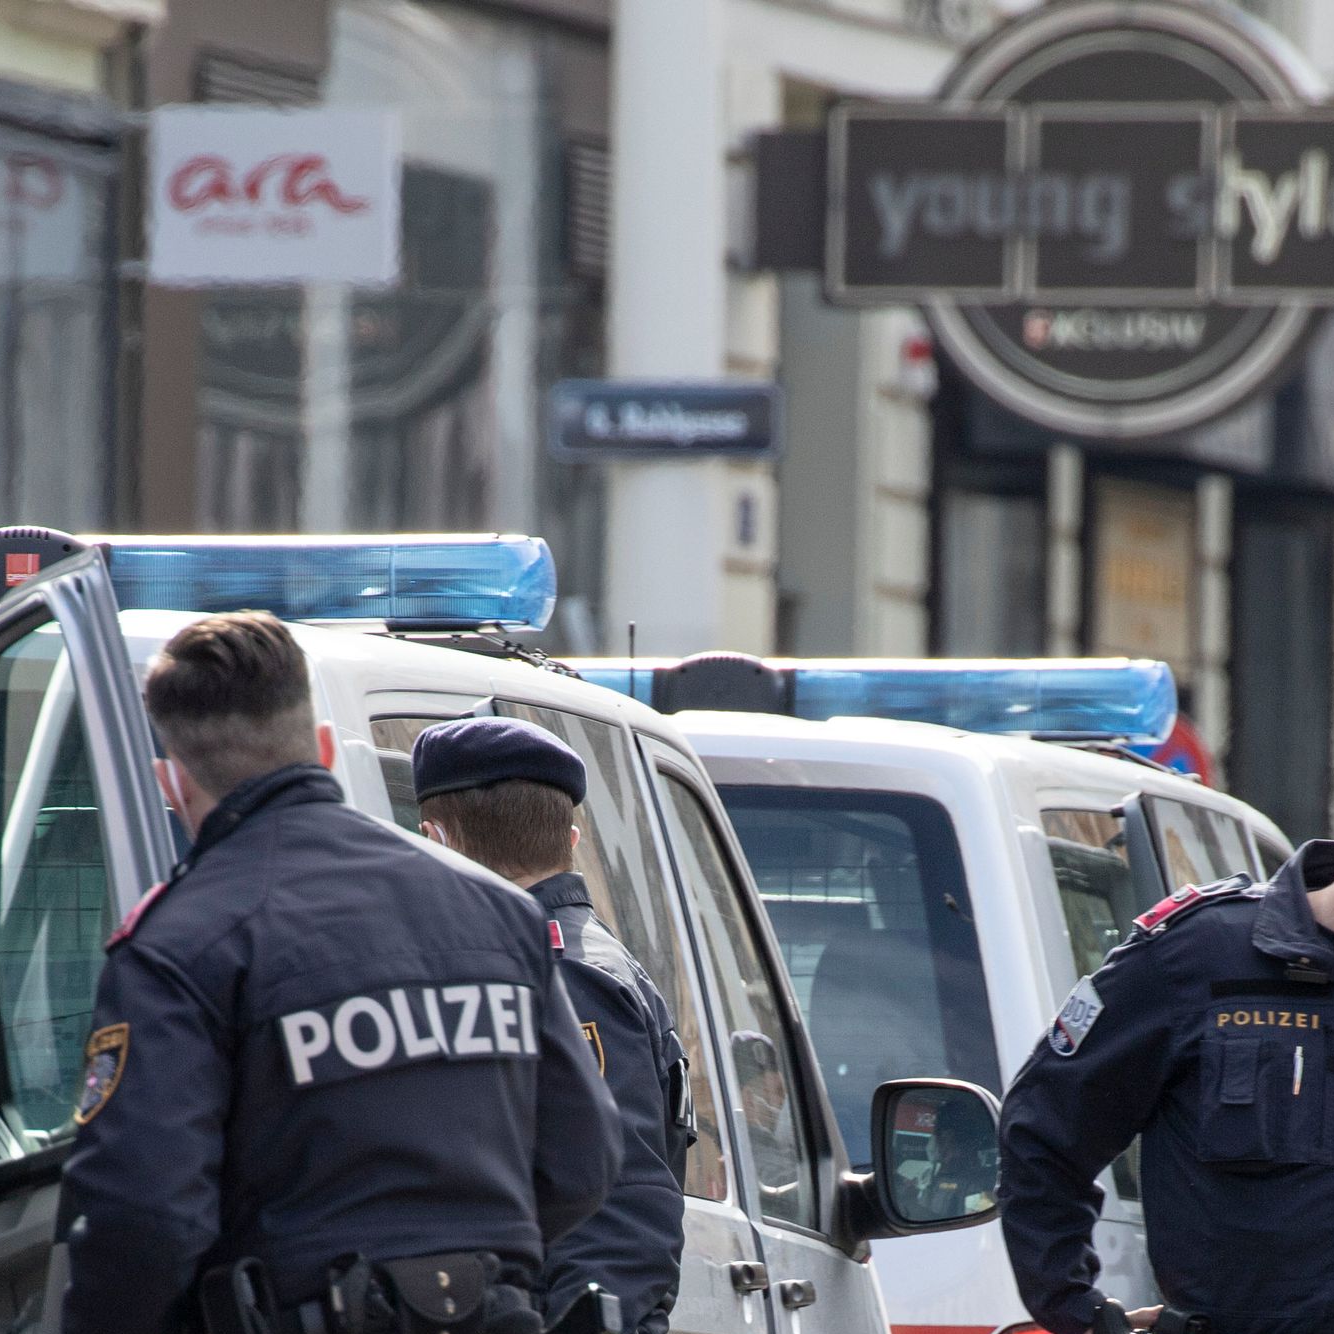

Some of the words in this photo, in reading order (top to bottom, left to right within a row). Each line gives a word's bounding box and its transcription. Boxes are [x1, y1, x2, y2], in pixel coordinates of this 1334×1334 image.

[168, 153, 371, 214] ara
[872, 168, 1132, 262] young
[280, 983, 539, 1084] POLIZEI
[1217, 1010, 1320, 1029] POLIZEI
